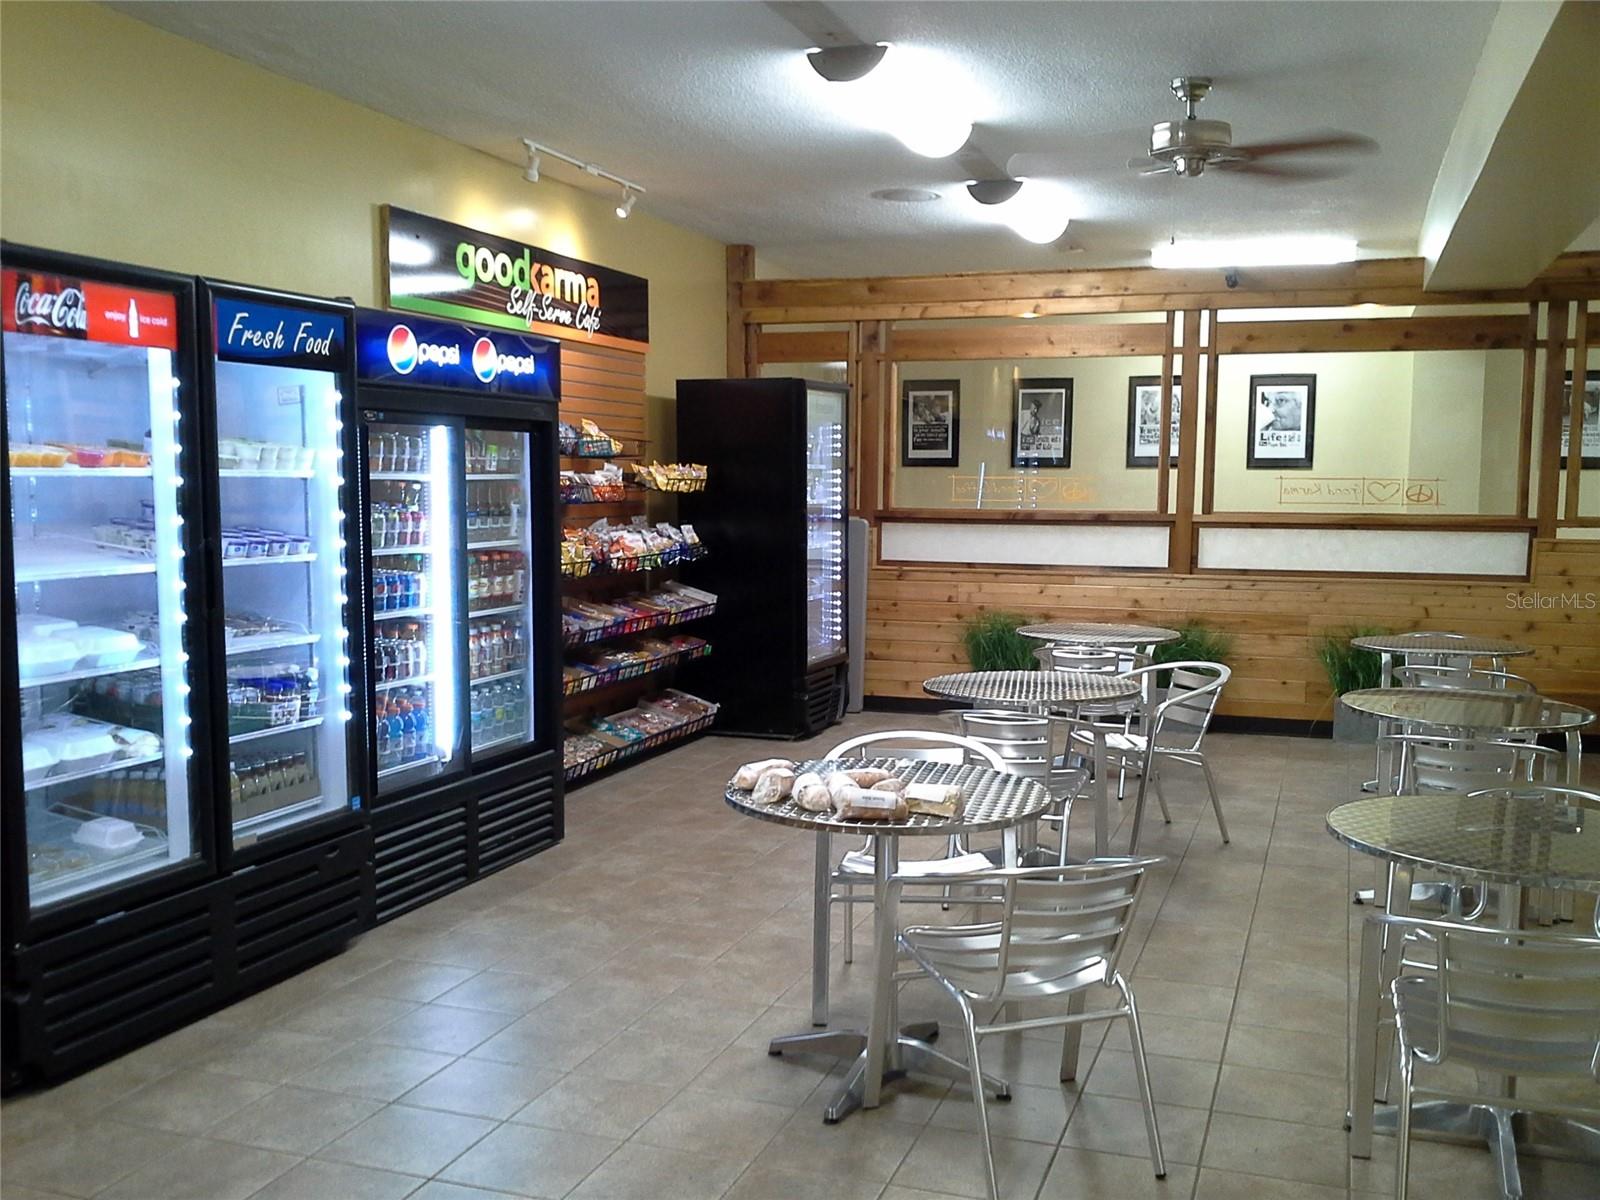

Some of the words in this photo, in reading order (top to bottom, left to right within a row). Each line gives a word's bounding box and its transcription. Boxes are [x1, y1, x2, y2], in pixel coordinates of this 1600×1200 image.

[507, 286, 573, 328] Self-Serve
[228, 312, 285, 350] Fresh
[293, 321, 334, 356] Food
[418, 343, 460, 367] pepsi
[497, 354, 535, 376] pepsi
